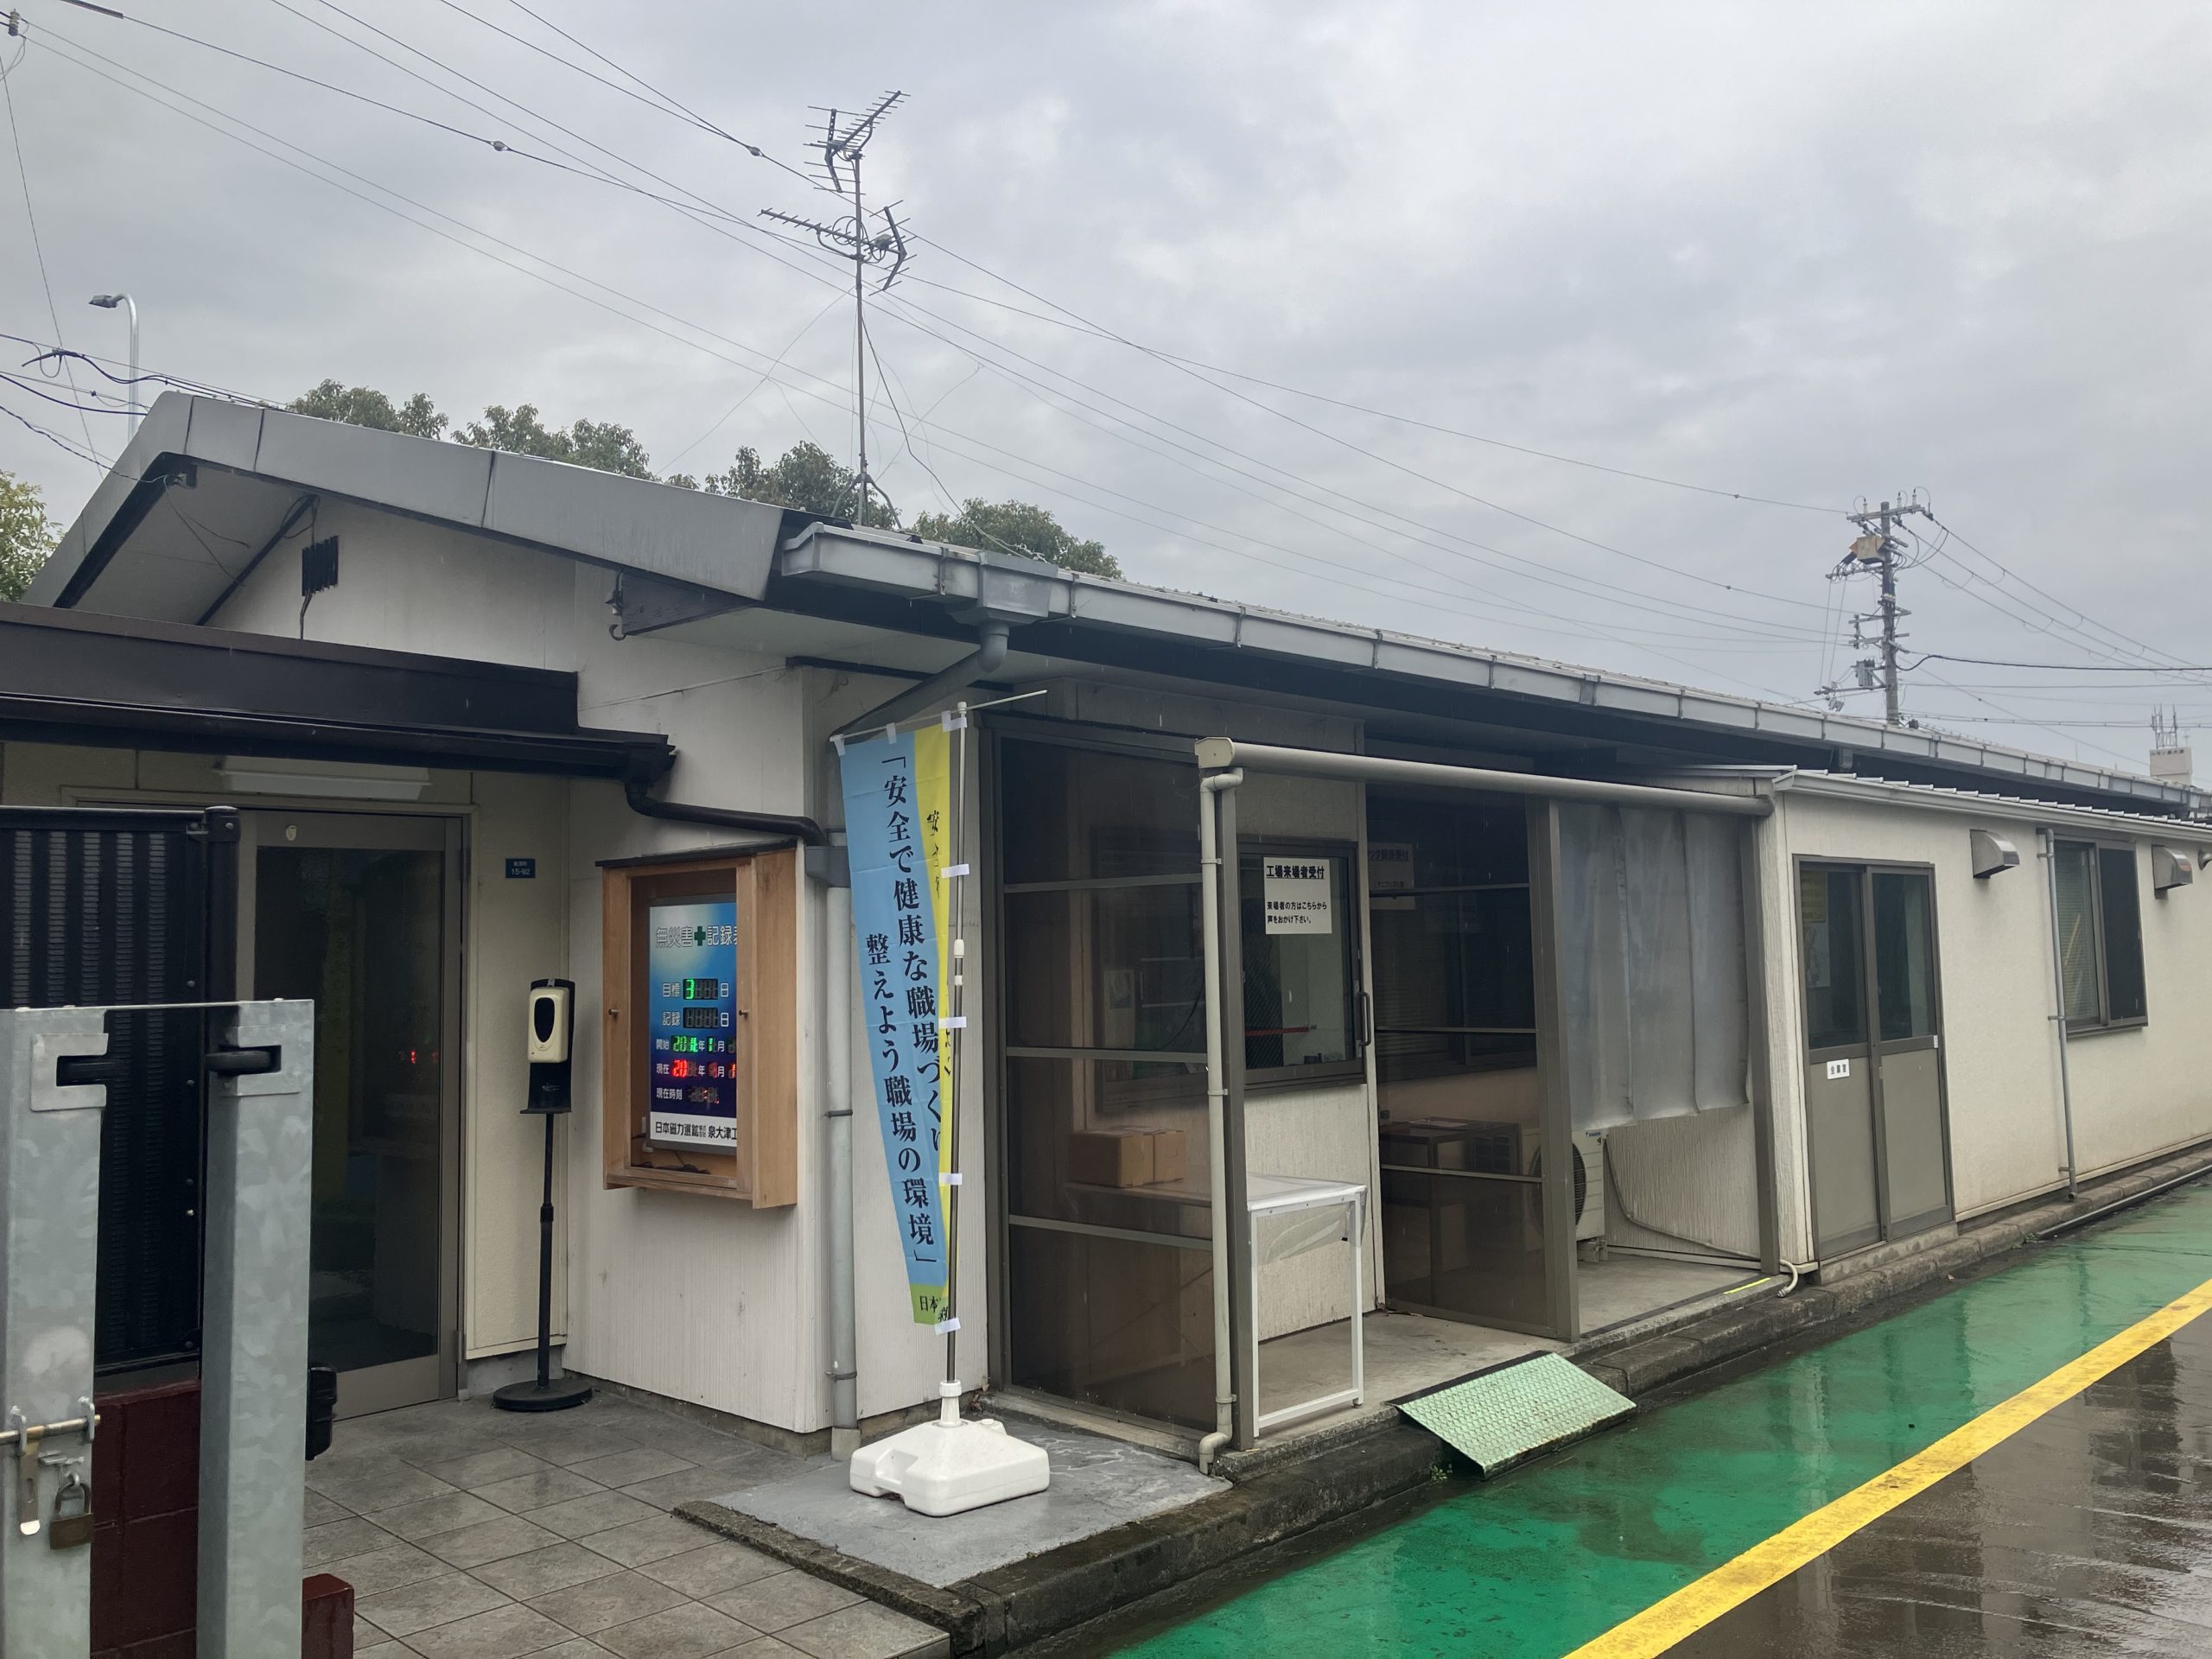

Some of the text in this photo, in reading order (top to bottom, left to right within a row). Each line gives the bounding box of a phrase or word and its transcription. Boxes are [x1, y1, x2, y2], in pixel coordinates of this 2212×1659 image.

[1266, 864, 1325, 879] 工場来場者受付
[1267, 901, 1327, 910] 来場者の方はこちらから
[1267, 915, 1312, 925] 声をおかけ下さい。
[656, 926, 693, 948] 無災害
[663, 982, 680, 997] 目標
[720, 982, 729, 997] 日
[662, 1011, 729, 1027] 記録 日
[656, 1038, 670, 1051] 開始
[656, 1063, 670, 1074] 現在
[656, 1087, 683, 1101] 現在時刻
[865, 933, 937, 1263] 整えよう職場の環境」
[919, 1295, 941, 1313] 日本
